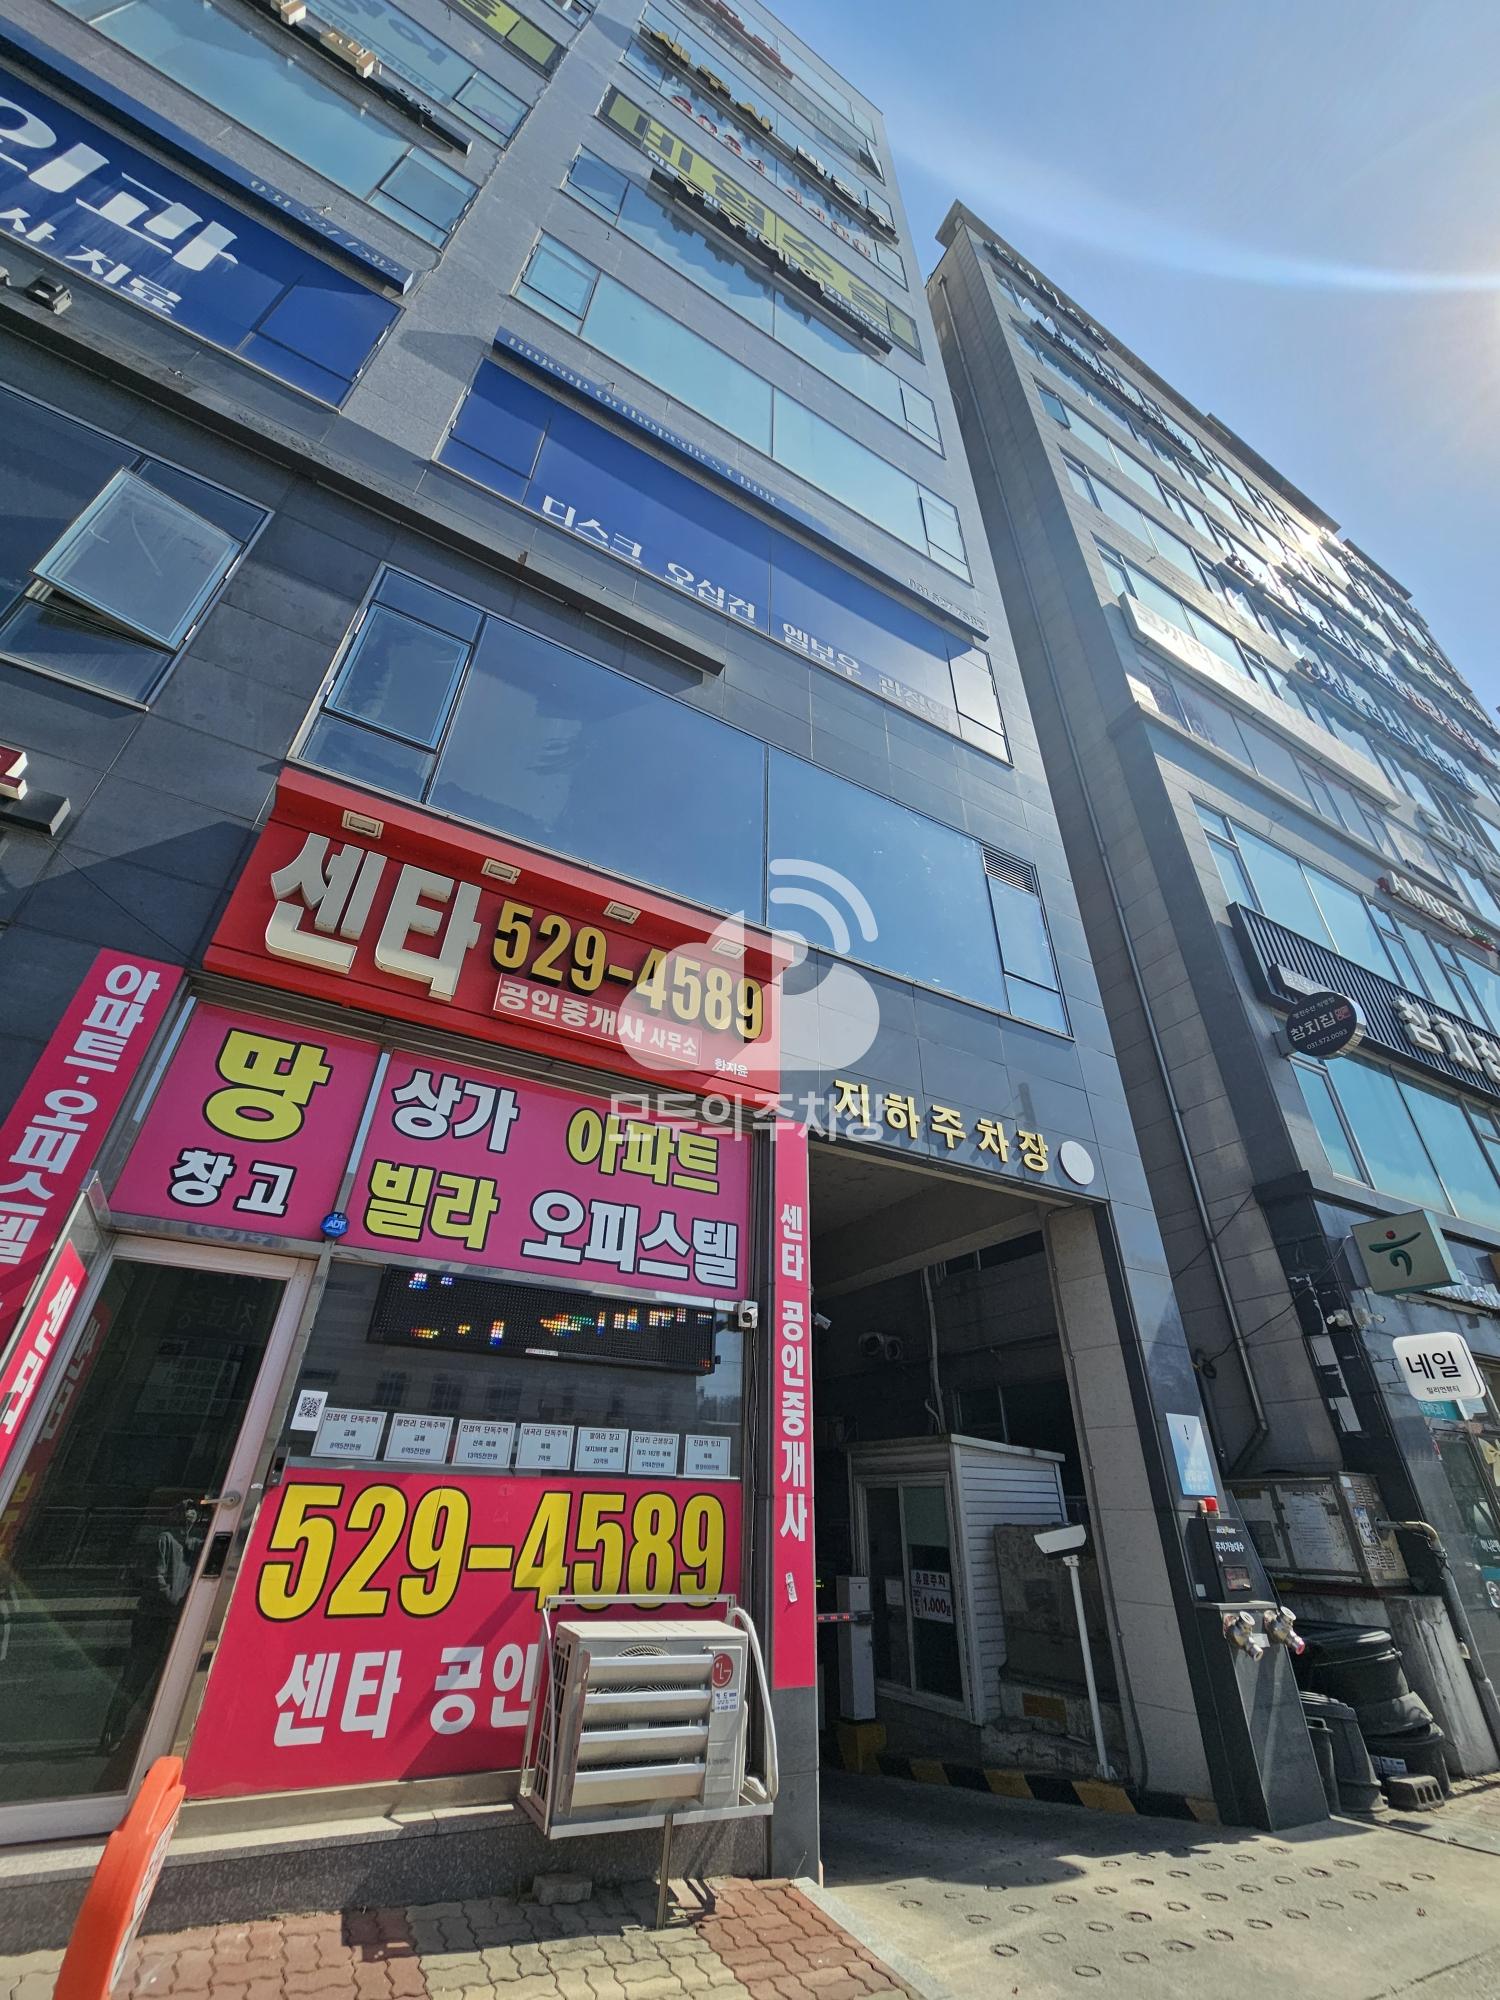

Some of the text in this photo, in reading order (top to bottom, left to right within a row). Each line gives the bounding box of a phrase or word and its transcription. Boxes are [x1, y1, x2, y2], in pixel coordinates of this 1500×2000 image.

[65, 244, 182, 314] 치료
[542, 495, 643, 566] 디스크
[664, 562, 756, 625] 오십견
[782, 623, 863, 677] 엘보우
[264, 832, 482, 1000] 센타
[1386, 869, 1475, 938] AMBER
[490, 899, 764, 1043] 529-4589
[497, 978, 699, 1057] 공인중개사 사무소
[1290, 1011, 1337, 1042] 참치집
[204, 1028, 333, 1143] 땅
[713, 1057, 749, 1078] 한지윤
[392, 1069, 720, 1194] 상가 아파트
[832, 1079, 1050, 1174] 지하주차장
[168, 1148, 298, 1217] 창고
[363, 1159, 740, 1289] 빌라 오피스텔
[780, 1203, 804, 1281] 센타
[1405, 1350, 1462, 1379] 네일
[350, 1415, 379, 1425] 단독주택
[419, 1420, 446, 1430] 단독주택
[484, 1425, 509, 1434] 단독주택
[780, 1301, 808, 1542] 공인중개사
[255, 1482, 725, 1623] 529-4589
[272, 1649, 402, 1747] 센타
